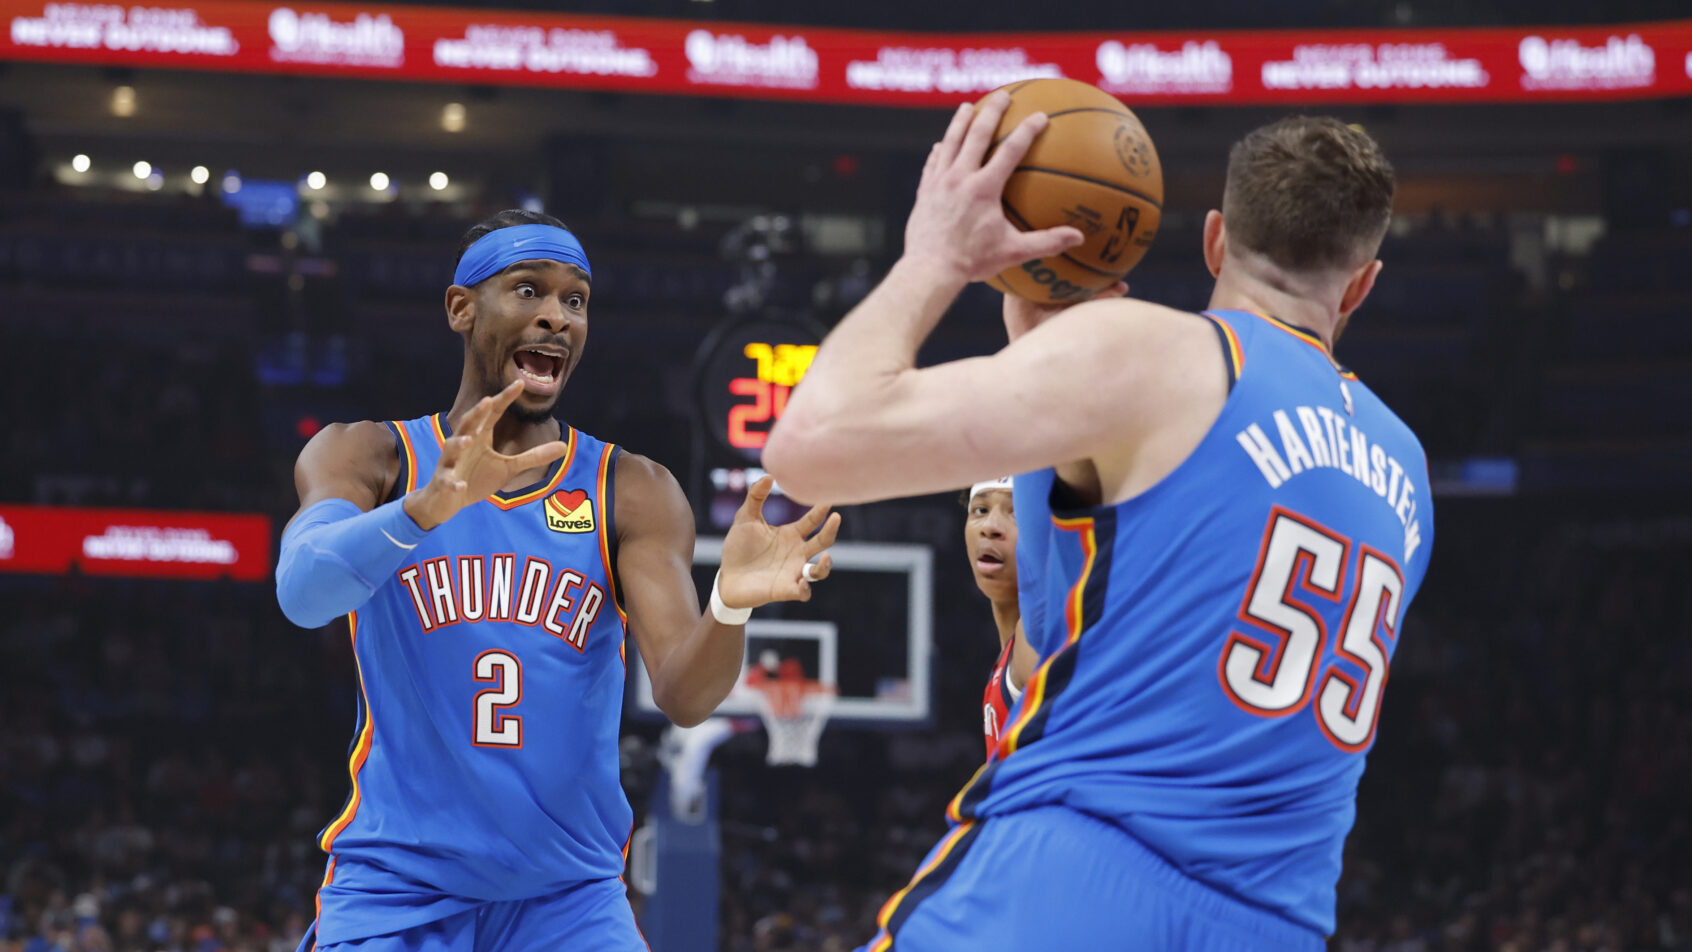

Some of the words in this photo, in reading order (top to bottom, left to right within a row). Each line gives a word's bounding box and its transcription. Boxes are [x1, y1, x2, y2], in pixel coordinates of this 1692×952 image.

[398, 553, 606, 654] THUNDER
[1217, 503, 1405, 753] 55
[472, 648, 523, 749] 2
